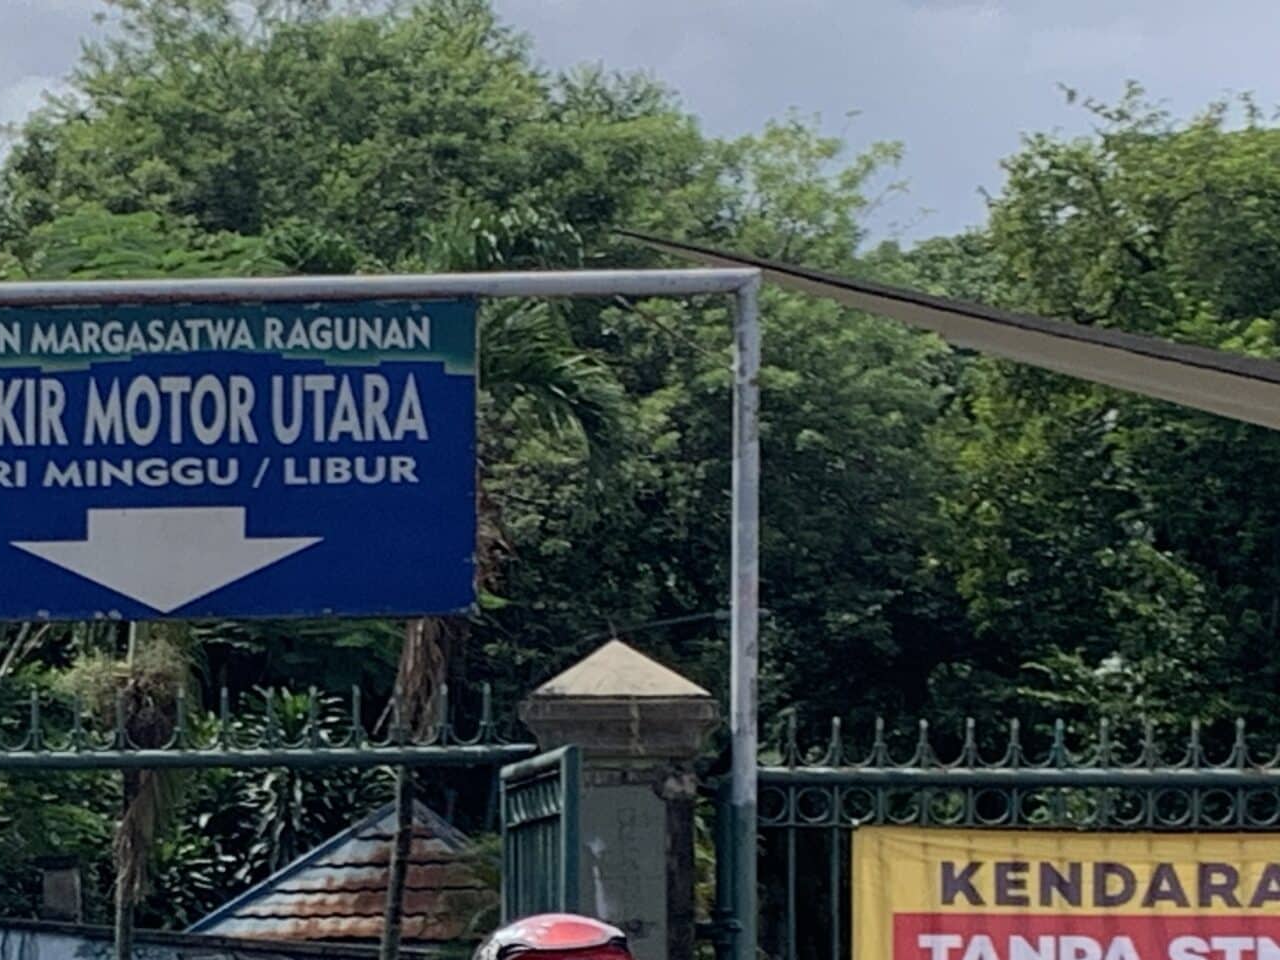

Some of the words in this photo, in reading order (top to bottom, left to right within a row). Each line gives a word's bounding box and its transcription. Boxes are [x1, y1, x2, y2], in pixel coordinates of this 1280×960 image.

[31, 318, 253, 353] MARGASATWA
[268, 316, 431, 350] RAGUNAN
[84, 373, 257, 445] MOTOR
[272, 372, 428, 443] UTARA
[42, 458, 239, 486] MINGGU
[252, 458, 271, 488] /
[284, 457, 418, 484] LIBUR
